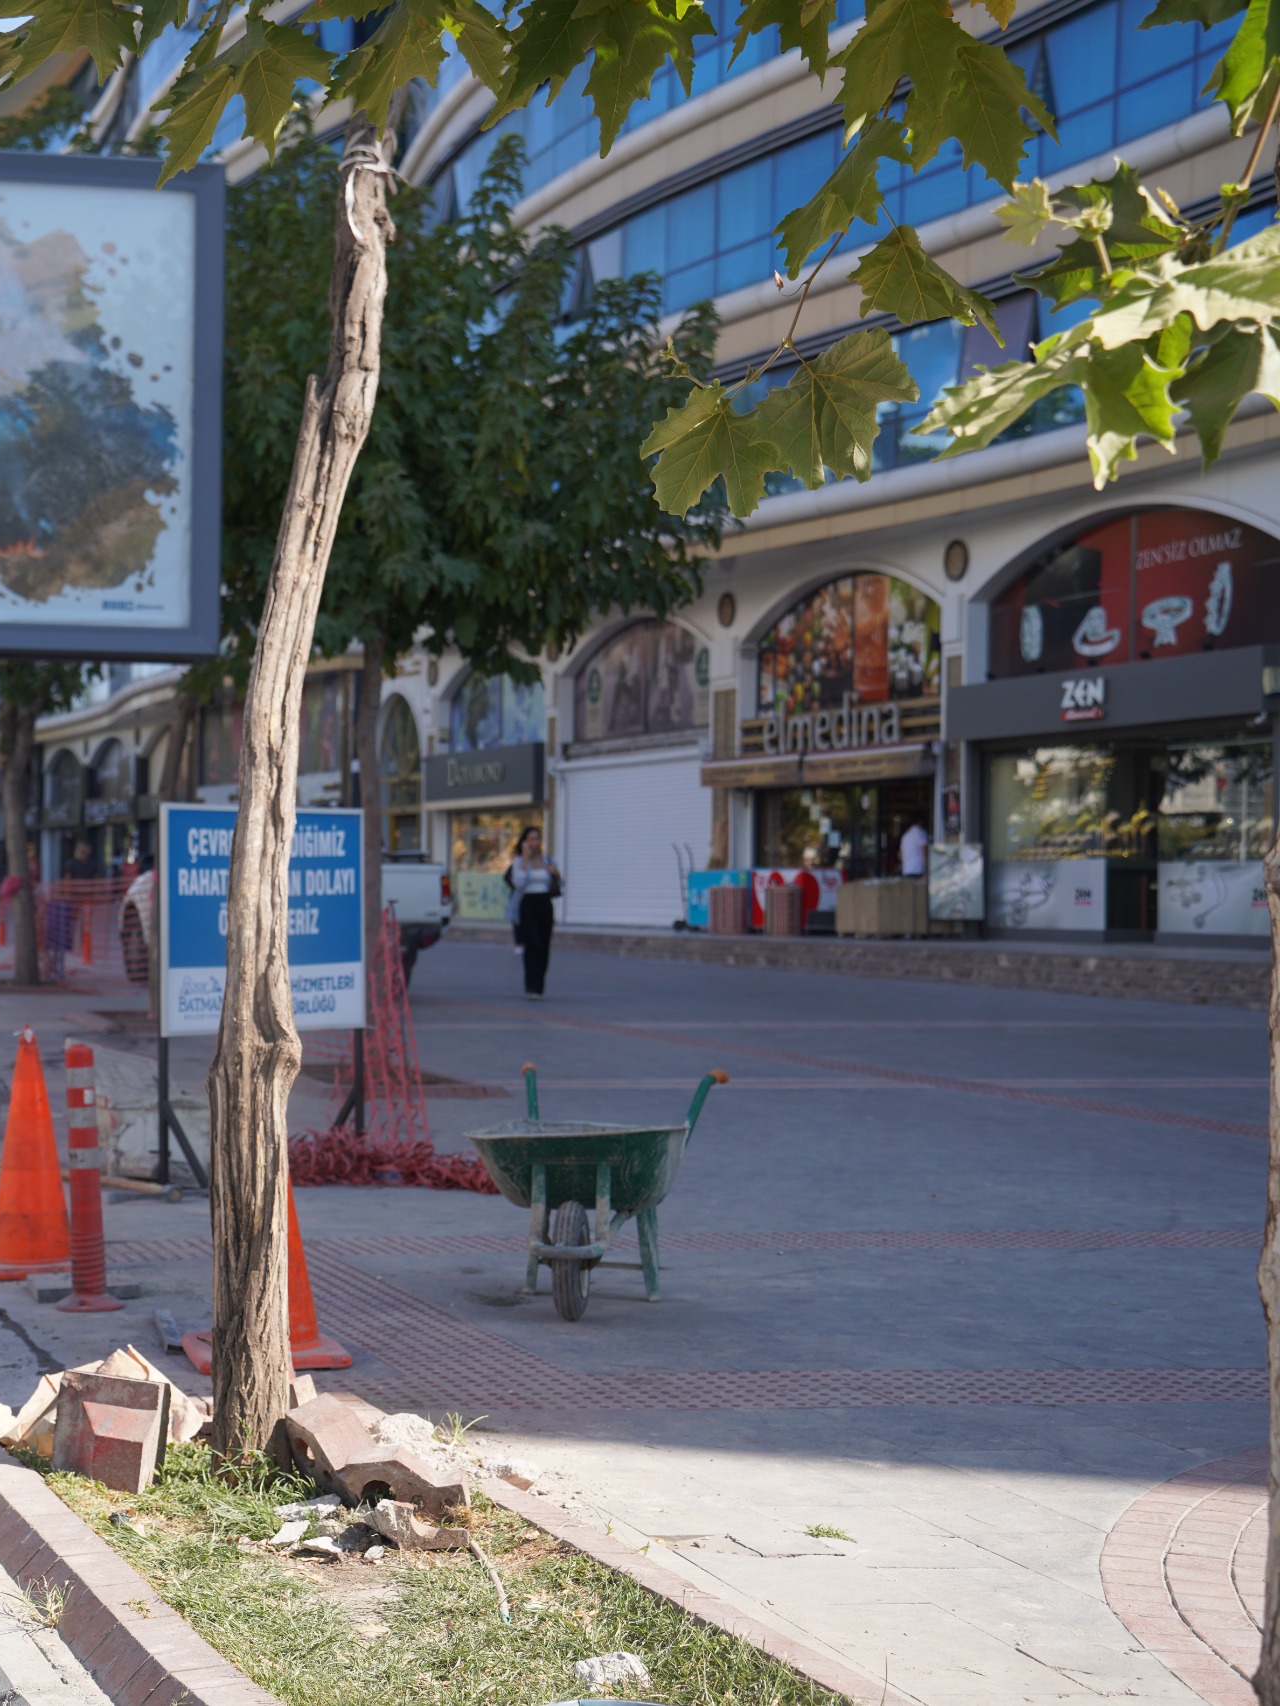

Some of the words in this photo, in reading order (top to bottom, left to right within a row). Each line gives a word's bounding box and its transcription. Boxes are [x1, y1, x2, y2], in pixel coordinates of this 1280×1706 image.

[1061, 676, 1105, 709] ZEN
[762, 690, 900, 756] elmedina
[305, 867, 356, 897] DOLAYI
